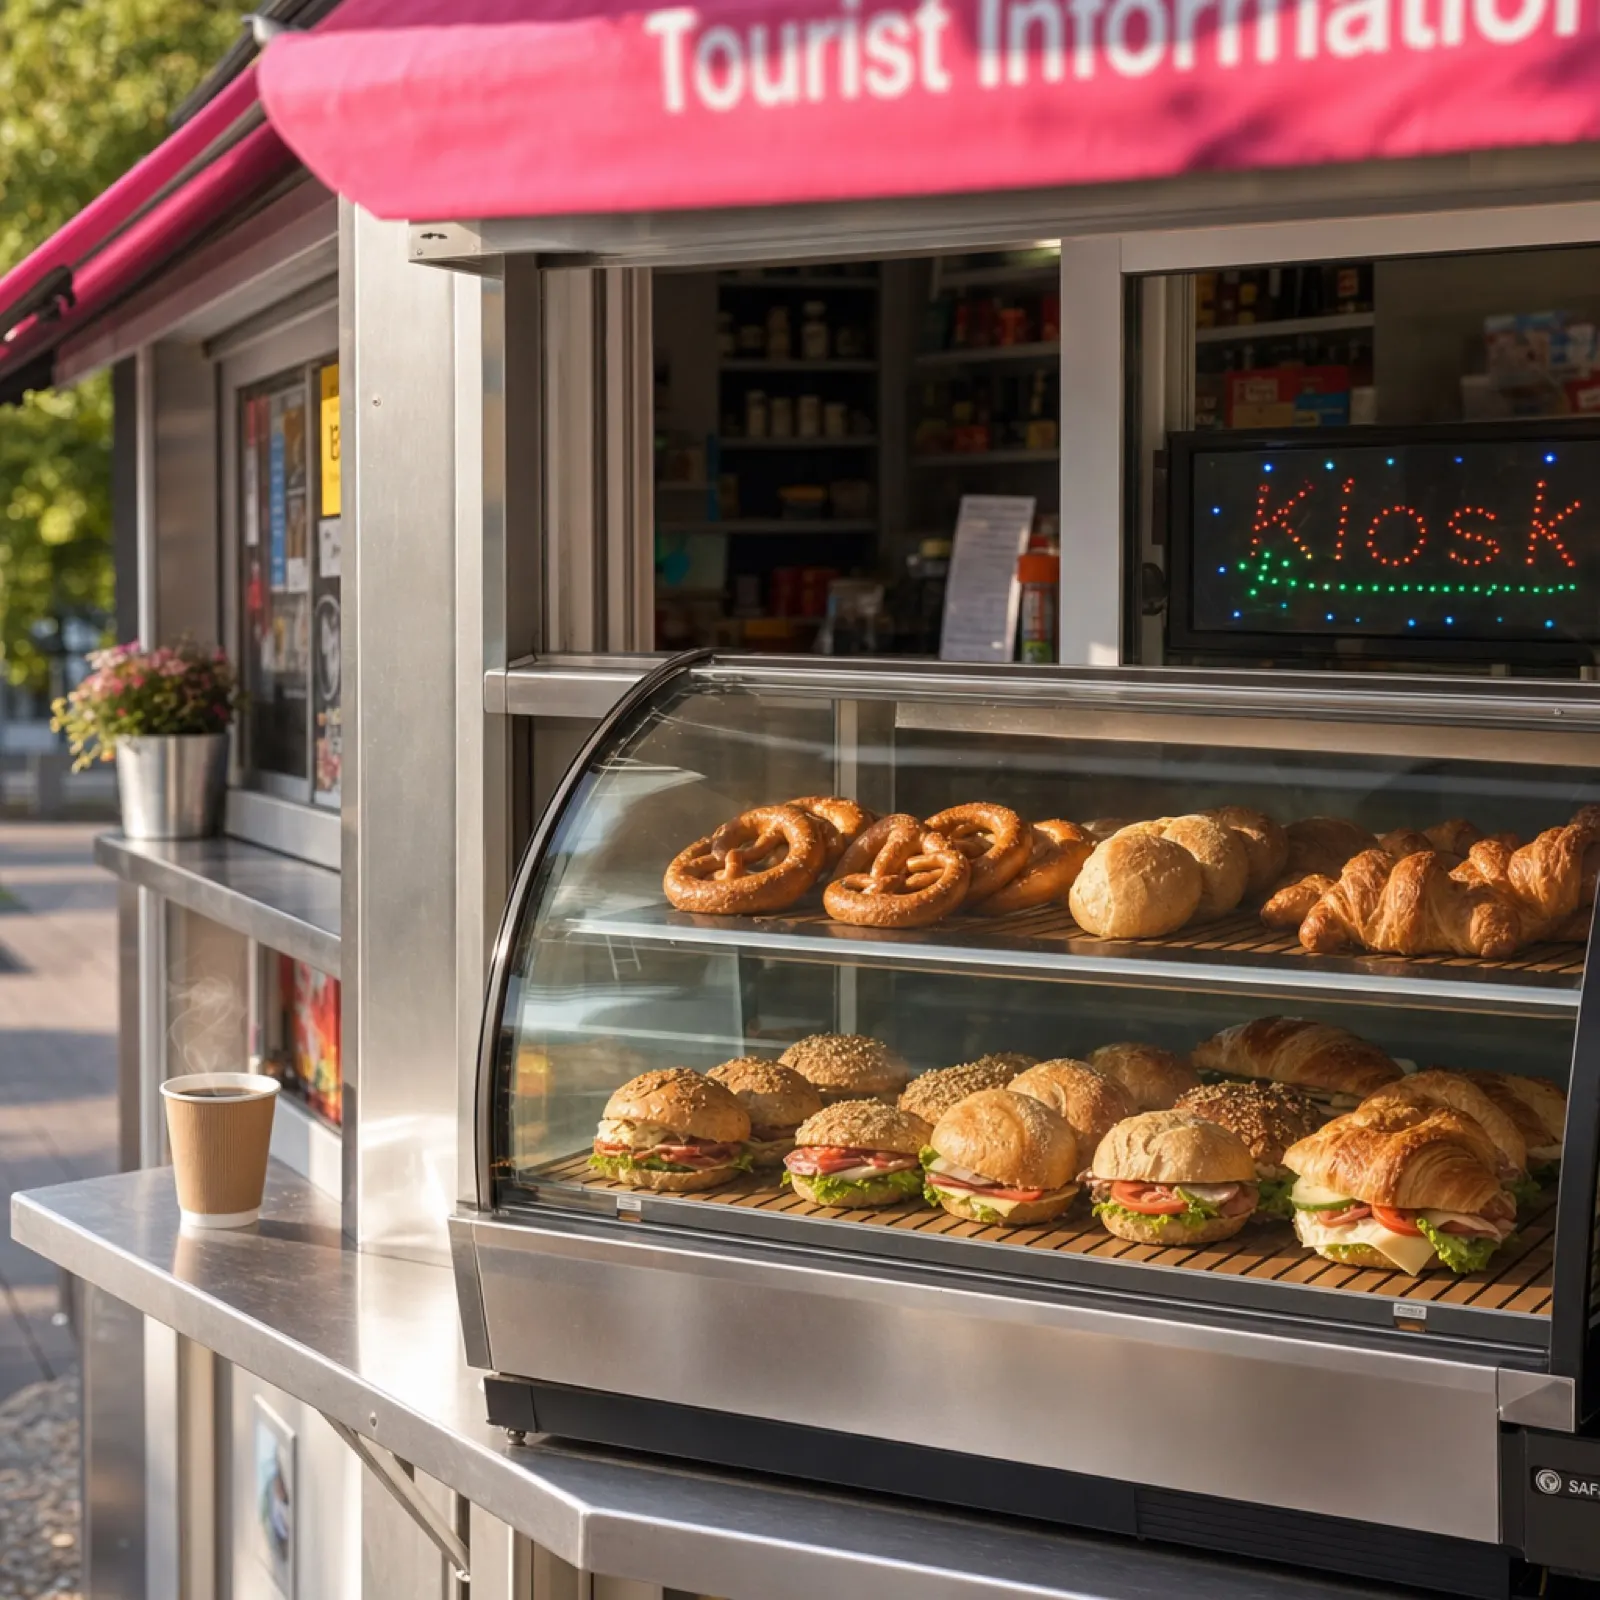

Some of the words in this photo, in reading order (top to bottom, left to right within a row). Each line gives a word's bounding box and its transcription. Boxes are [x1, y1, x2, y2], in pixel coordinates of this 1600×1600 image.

[645, 0, 951, 114] Tourist
[1250, 477, 1581, 567] Kiosk
[1568, 1479, 1600, 1497] SAF
